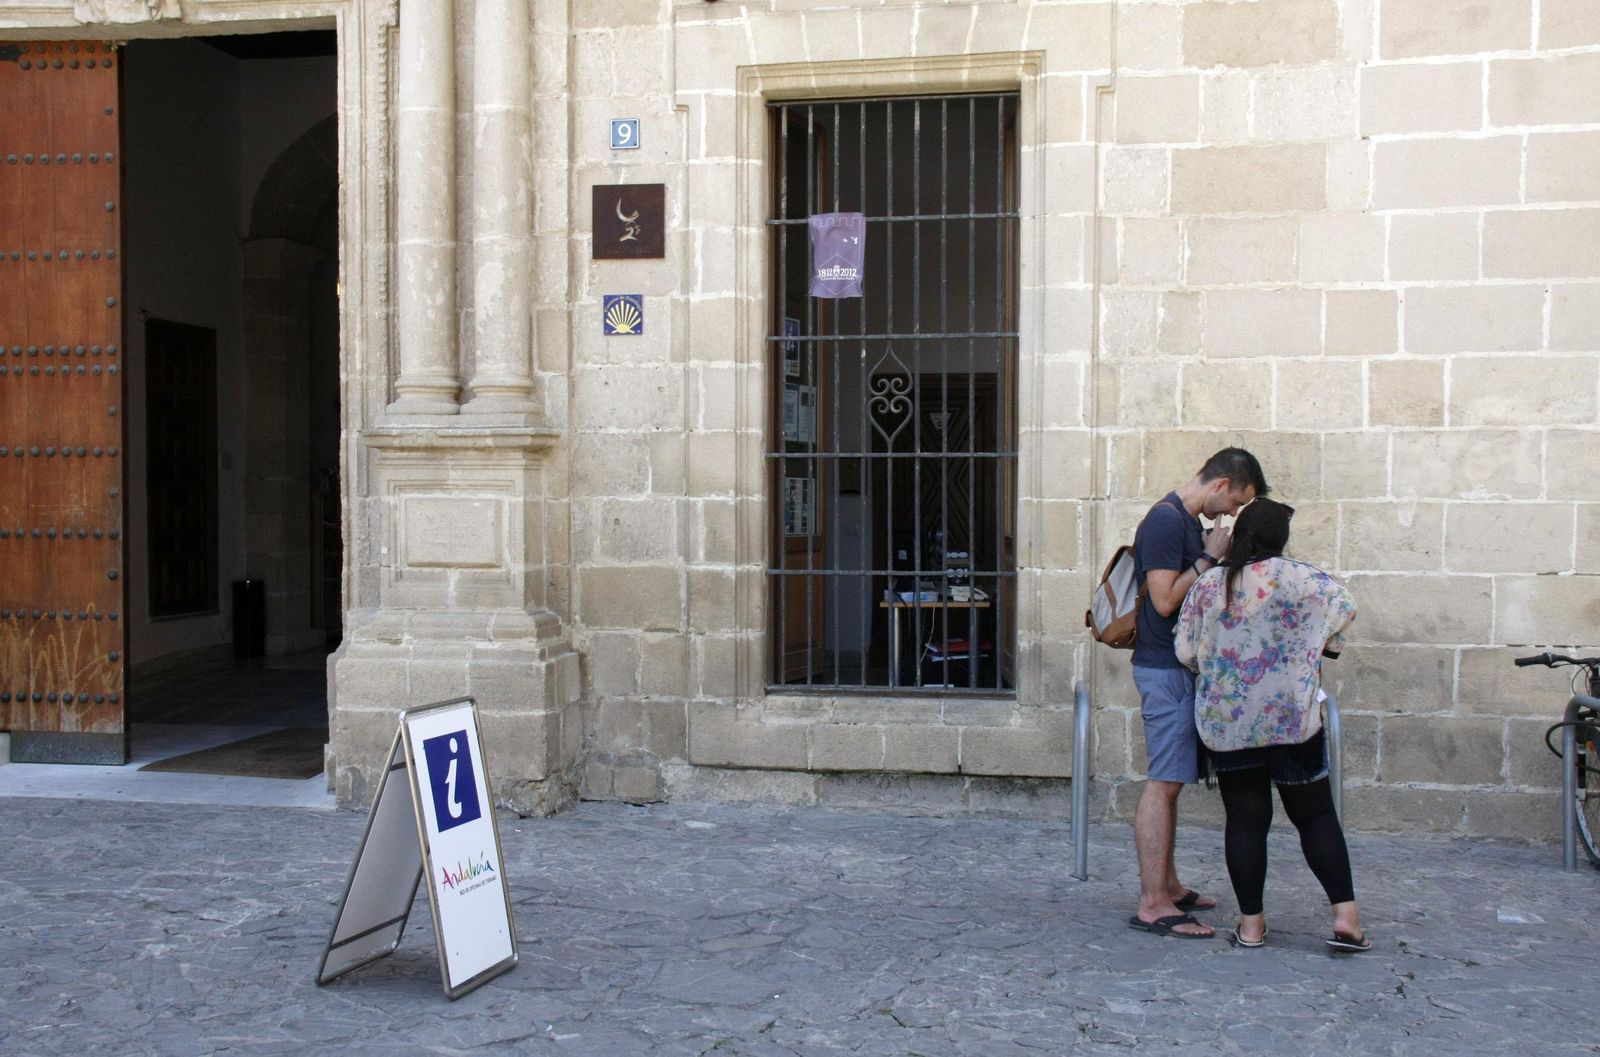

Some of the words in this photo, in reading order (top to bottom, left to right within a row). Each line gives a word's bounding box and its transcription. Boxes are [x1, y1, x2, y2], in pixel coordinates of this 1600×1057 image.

[618, 123, 632, 145] 9
[840, 267, 857, 277] 2012
[441, 850, 495, 892] Andalucía
